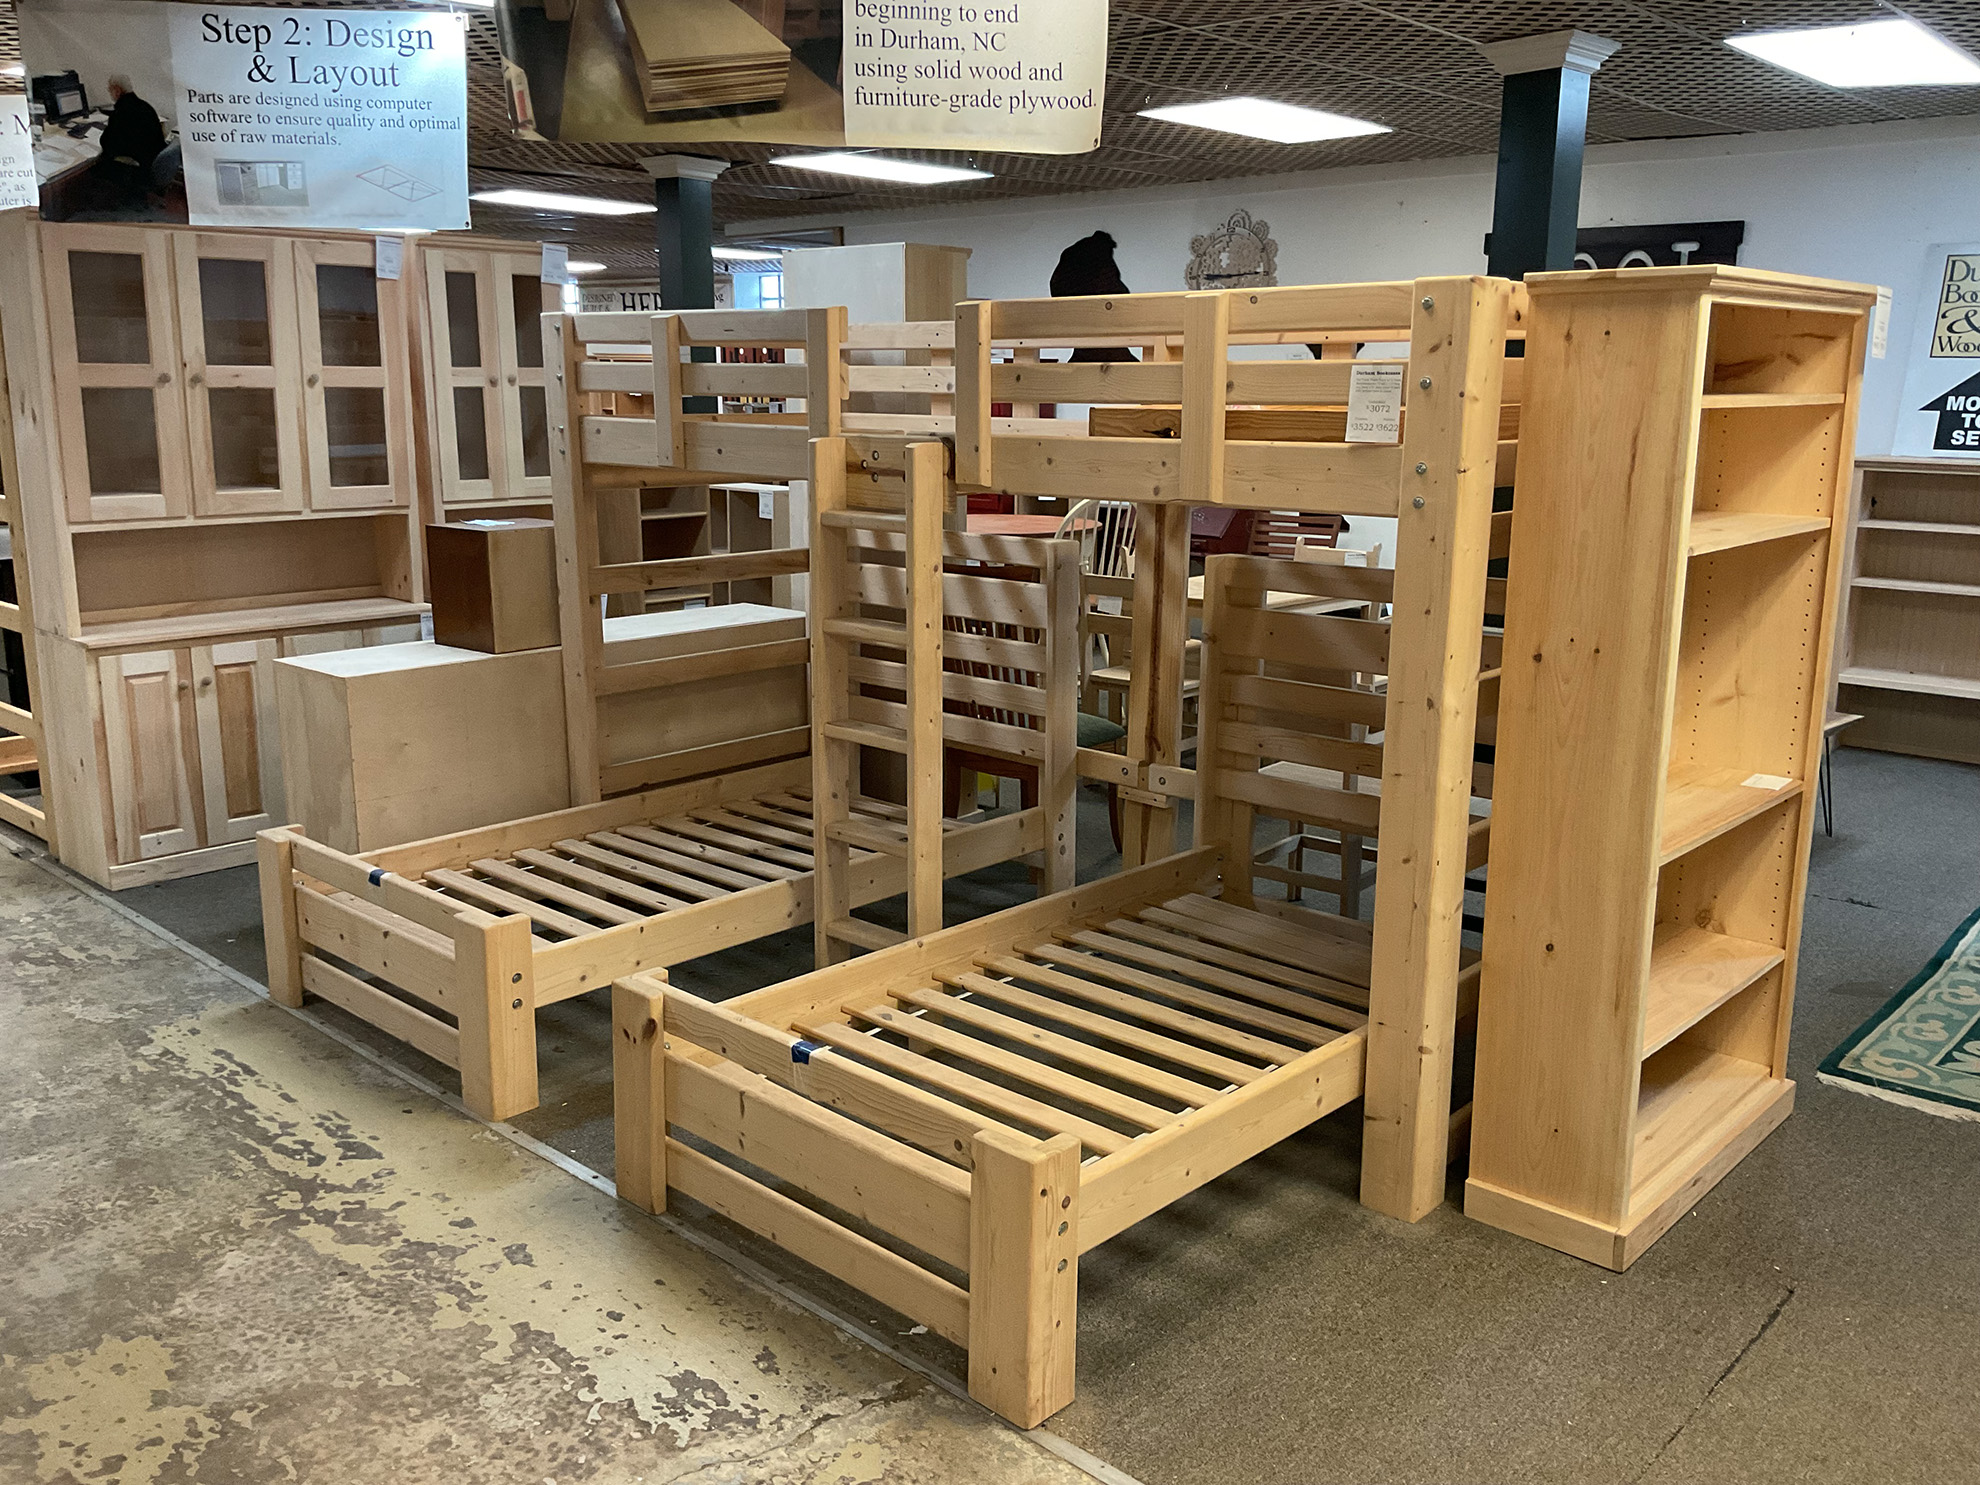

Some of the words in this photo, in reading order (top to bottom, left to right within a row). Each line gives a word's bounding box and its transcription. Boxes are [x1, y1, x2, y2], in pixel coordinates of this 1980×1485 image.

[855, 0, 952, 27] beginning
[959, 4, 977, 22] to
[984, 4, 1019, 23] end
[201, 13, 271, 53] Step
[283, 17, 311, 46] 2:
[323, 19, 435, 58] Design
[855, 26, 873, 48] in
[880, 28, 966, 55] Durham,
[972, 31, 1006, 52] NC
[247, 54, 276, 83] &
[288, 56, 401, 93] Layout
[854, 57, 908, 83] using
[914, 59, 962, 79] solid
[968, 60, 1022, 80] wood
[1028, 62, 1063, 81] and
[187, 88, 224, 105] Parts
[228, 94, 251, 105] are
[255, 91, 319, 109] designed
[324, 94, 362, 112] using
[366, 98, 432, 113] computer
[854, 86, 1002, 113] furniture-grade
[1009, 88, 1097, 114] plywood.
[189, 108, 252, 123] software
[257, 113, 271, 125] to
[275, 115, 322, 126] ensure
[326, 113, 375, 131] quality
[379, 115, 405, 128] and
[409, 116, 461, 132] optimal
[191, 131, 216, 142] use
[220, 129, 237, 143] of
[240, 134, 267, 143] raw
[272, 131, 341, 146] materials.
[17, 169, 34, 178] cut
[14, 183, 26, 192] as
